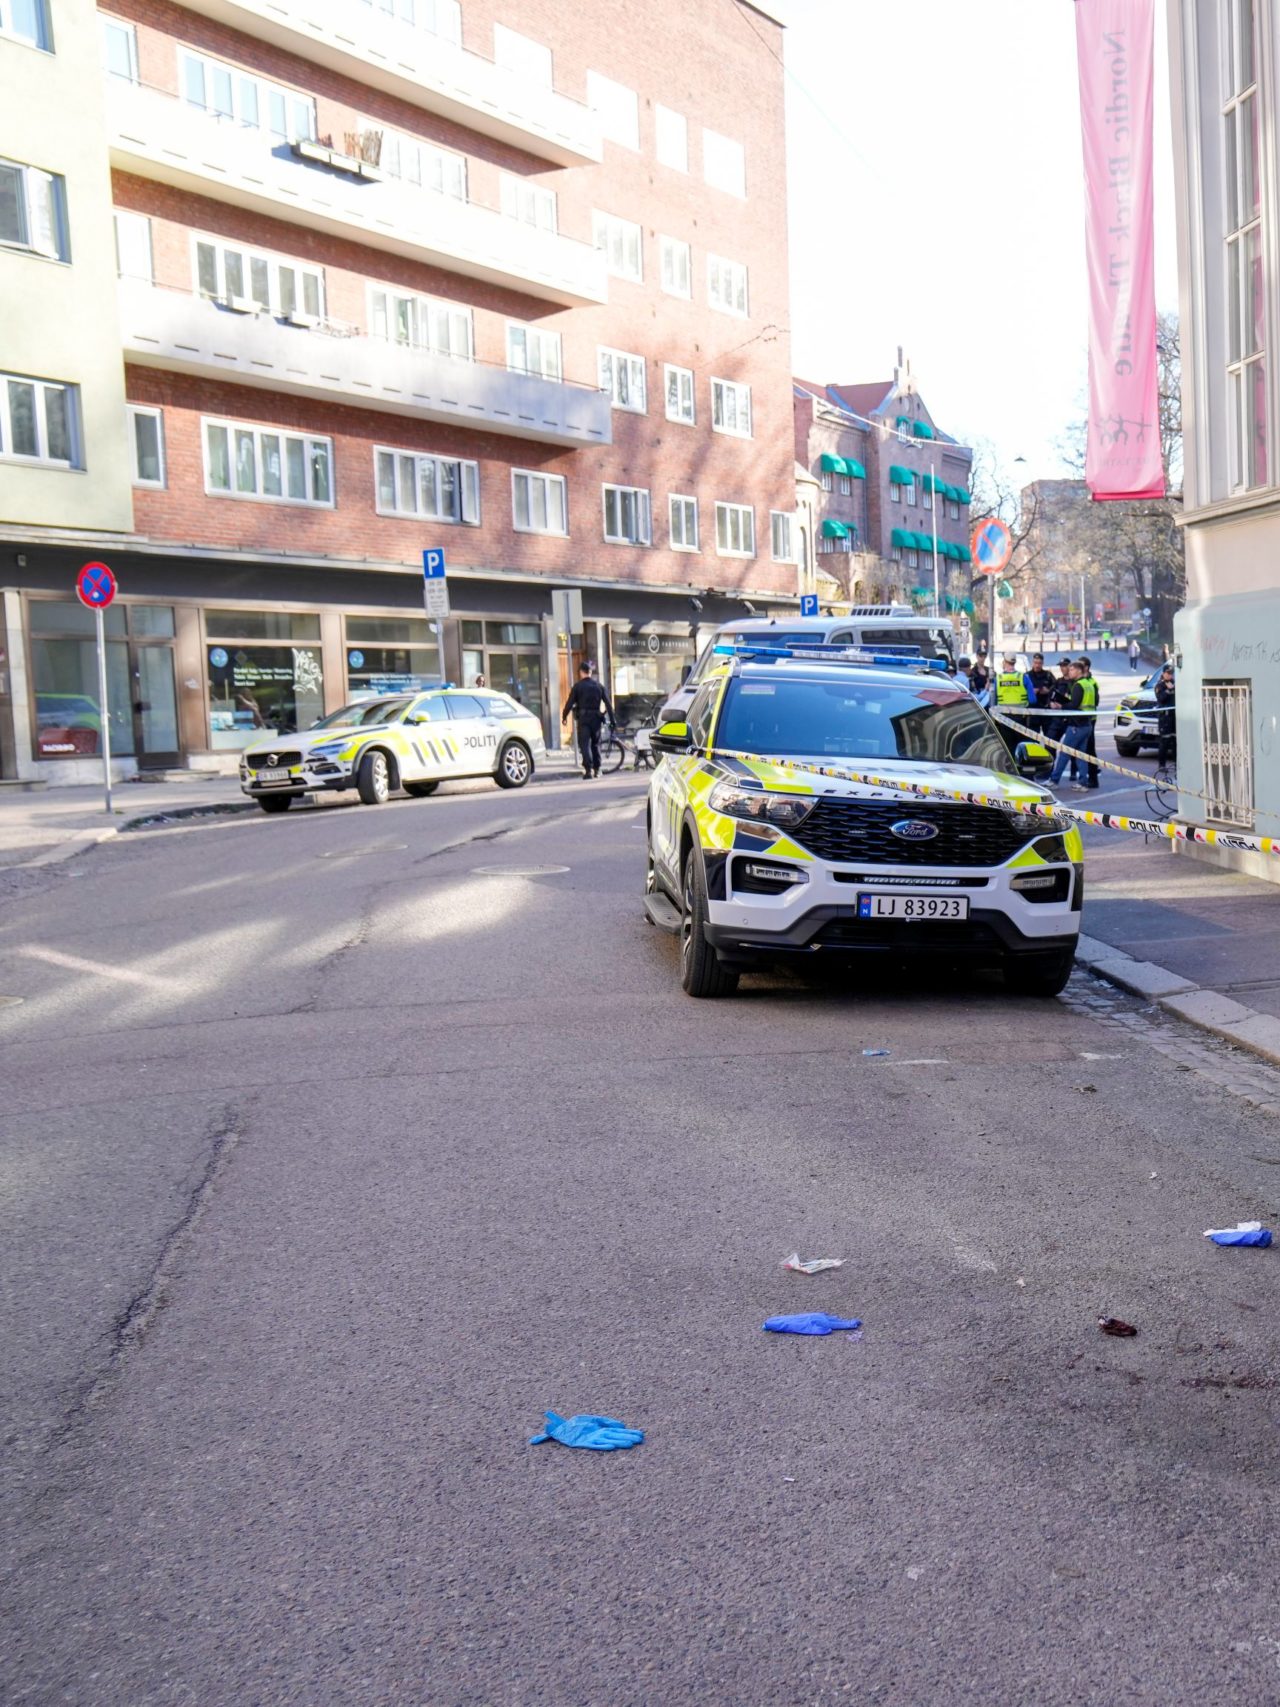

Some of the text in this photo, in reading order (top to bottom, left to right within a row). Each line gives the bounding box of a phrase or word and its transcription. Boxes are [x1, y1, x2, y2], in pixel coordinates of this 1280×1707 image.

[427, 552, 440, 576] P
[804, 596, 815, 615] P
[463, 734, 497, 749] POLITI
[902, 823, 929, 836] Ford
[1128, 820, 1165, 836] POLITI
[1217, 837, 1260, 852] POLITI
[877, 898, 961, 917] LJ 83923
